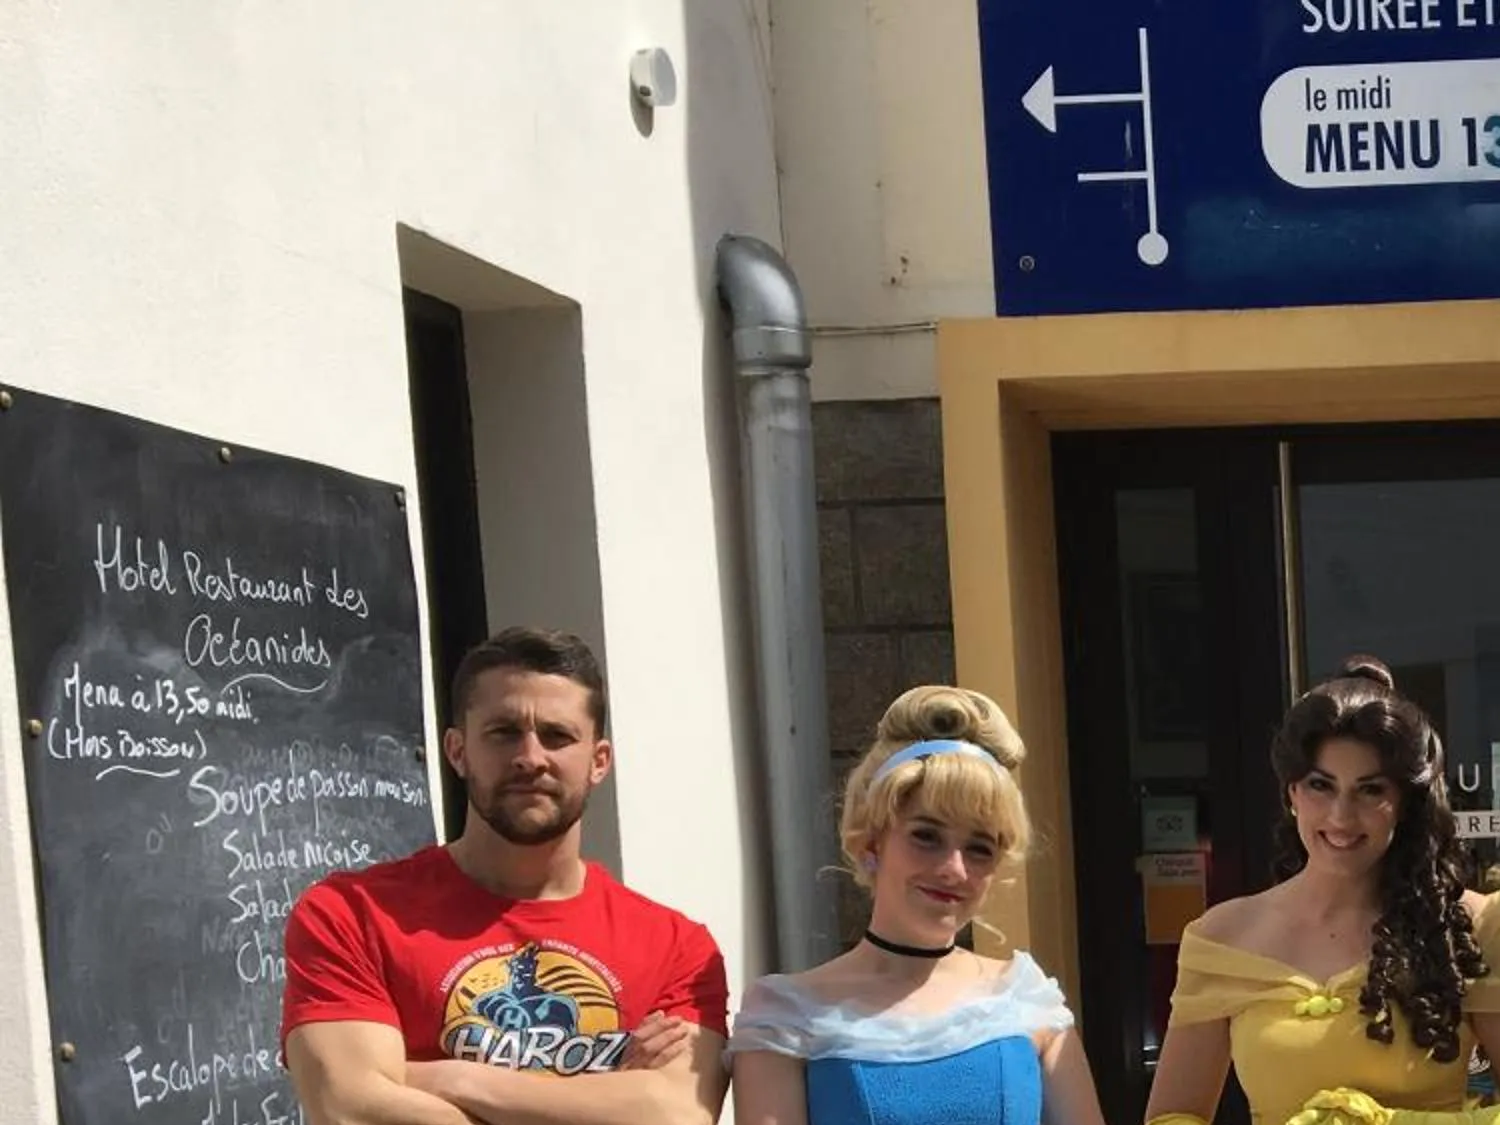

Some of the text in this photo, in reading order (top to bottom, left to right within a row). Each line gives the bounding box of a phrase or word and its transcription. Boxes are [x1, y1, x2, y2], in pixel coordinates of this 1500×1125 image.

[1305, 75, 1391, 111] le midi
[1305, 119, 1441, 173] MENU
[94, 523, 369, 619] Hotel Restaurant des
[189, 765, 282, 837] Soupe
[287, 748, 305, 802] de
[222, 828, 298, 879] Salade
[228, 877, 293, 924] Salad
[236, 929, 288, 983] Cha
[124, 1023, 241, 1115] Escalope
[453, 1025, 631, 1076] HAROZ
